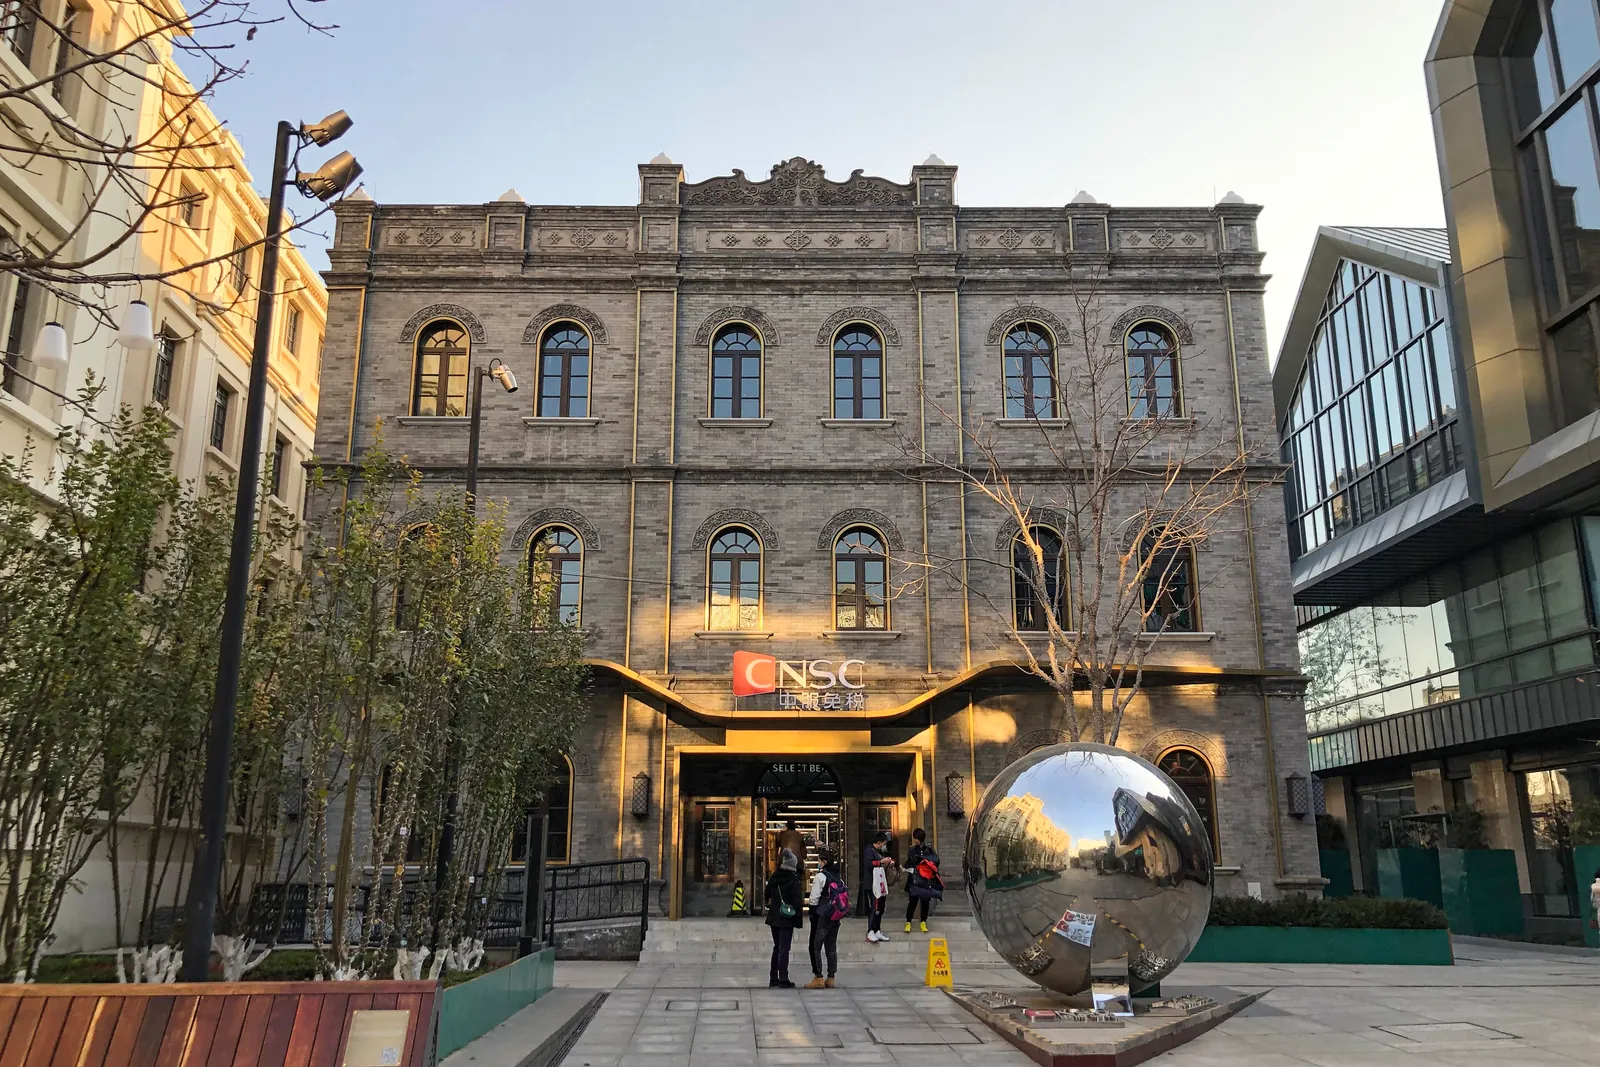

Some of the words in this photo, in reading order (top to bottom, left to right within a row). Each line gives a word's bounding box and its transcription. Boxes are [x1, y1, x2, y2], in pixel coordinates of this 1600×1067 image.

[745, 659, 866, 690] CNSC
[779, 691, 864, 710] 中服免税
